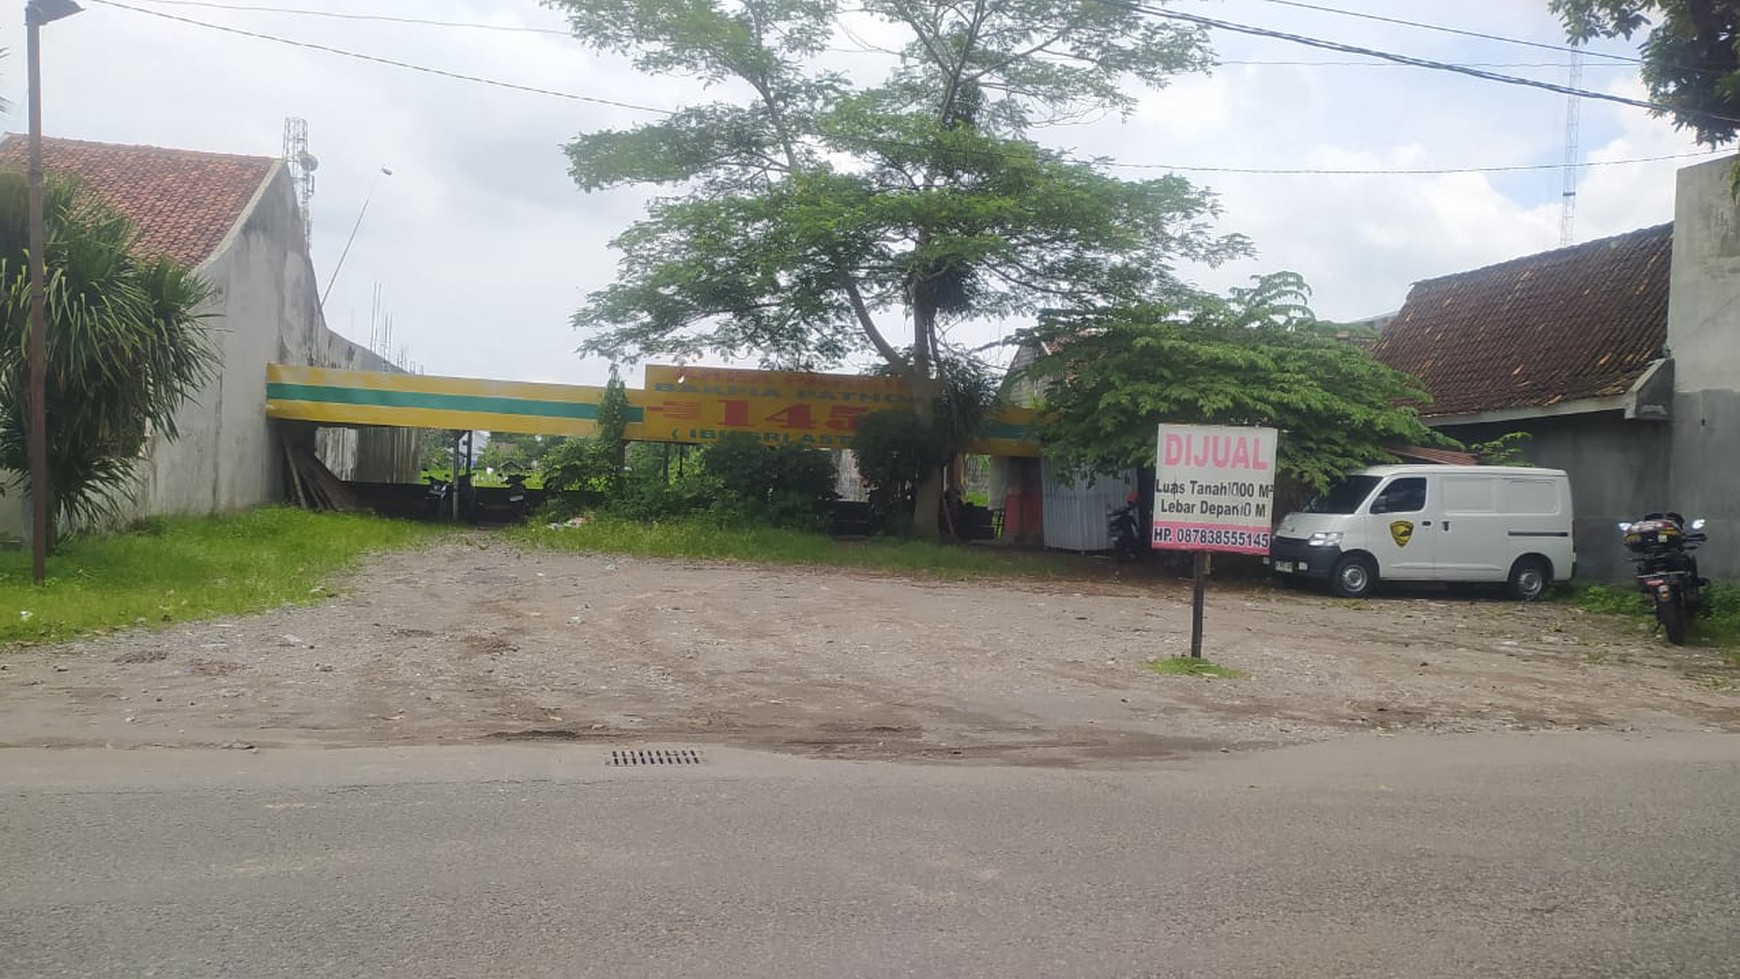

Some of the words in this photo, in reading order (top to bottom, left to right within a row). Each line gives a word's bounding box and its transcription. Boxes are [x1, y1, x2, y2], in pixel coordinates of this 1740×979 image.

[717, 398, 870, 430] 145
[1164, 432, 1269, 470] DIJUAL
[1155, 478, 1185, 494] Luas
[1190, 480, 1227, 496] Tanah
[1160, 499, 1197, 514] Lebar
[1255, 503, 1266, 518] M
[1153, 528, 1172, 541] HP.
[1177, 528, 1270, 548] 087838555145
